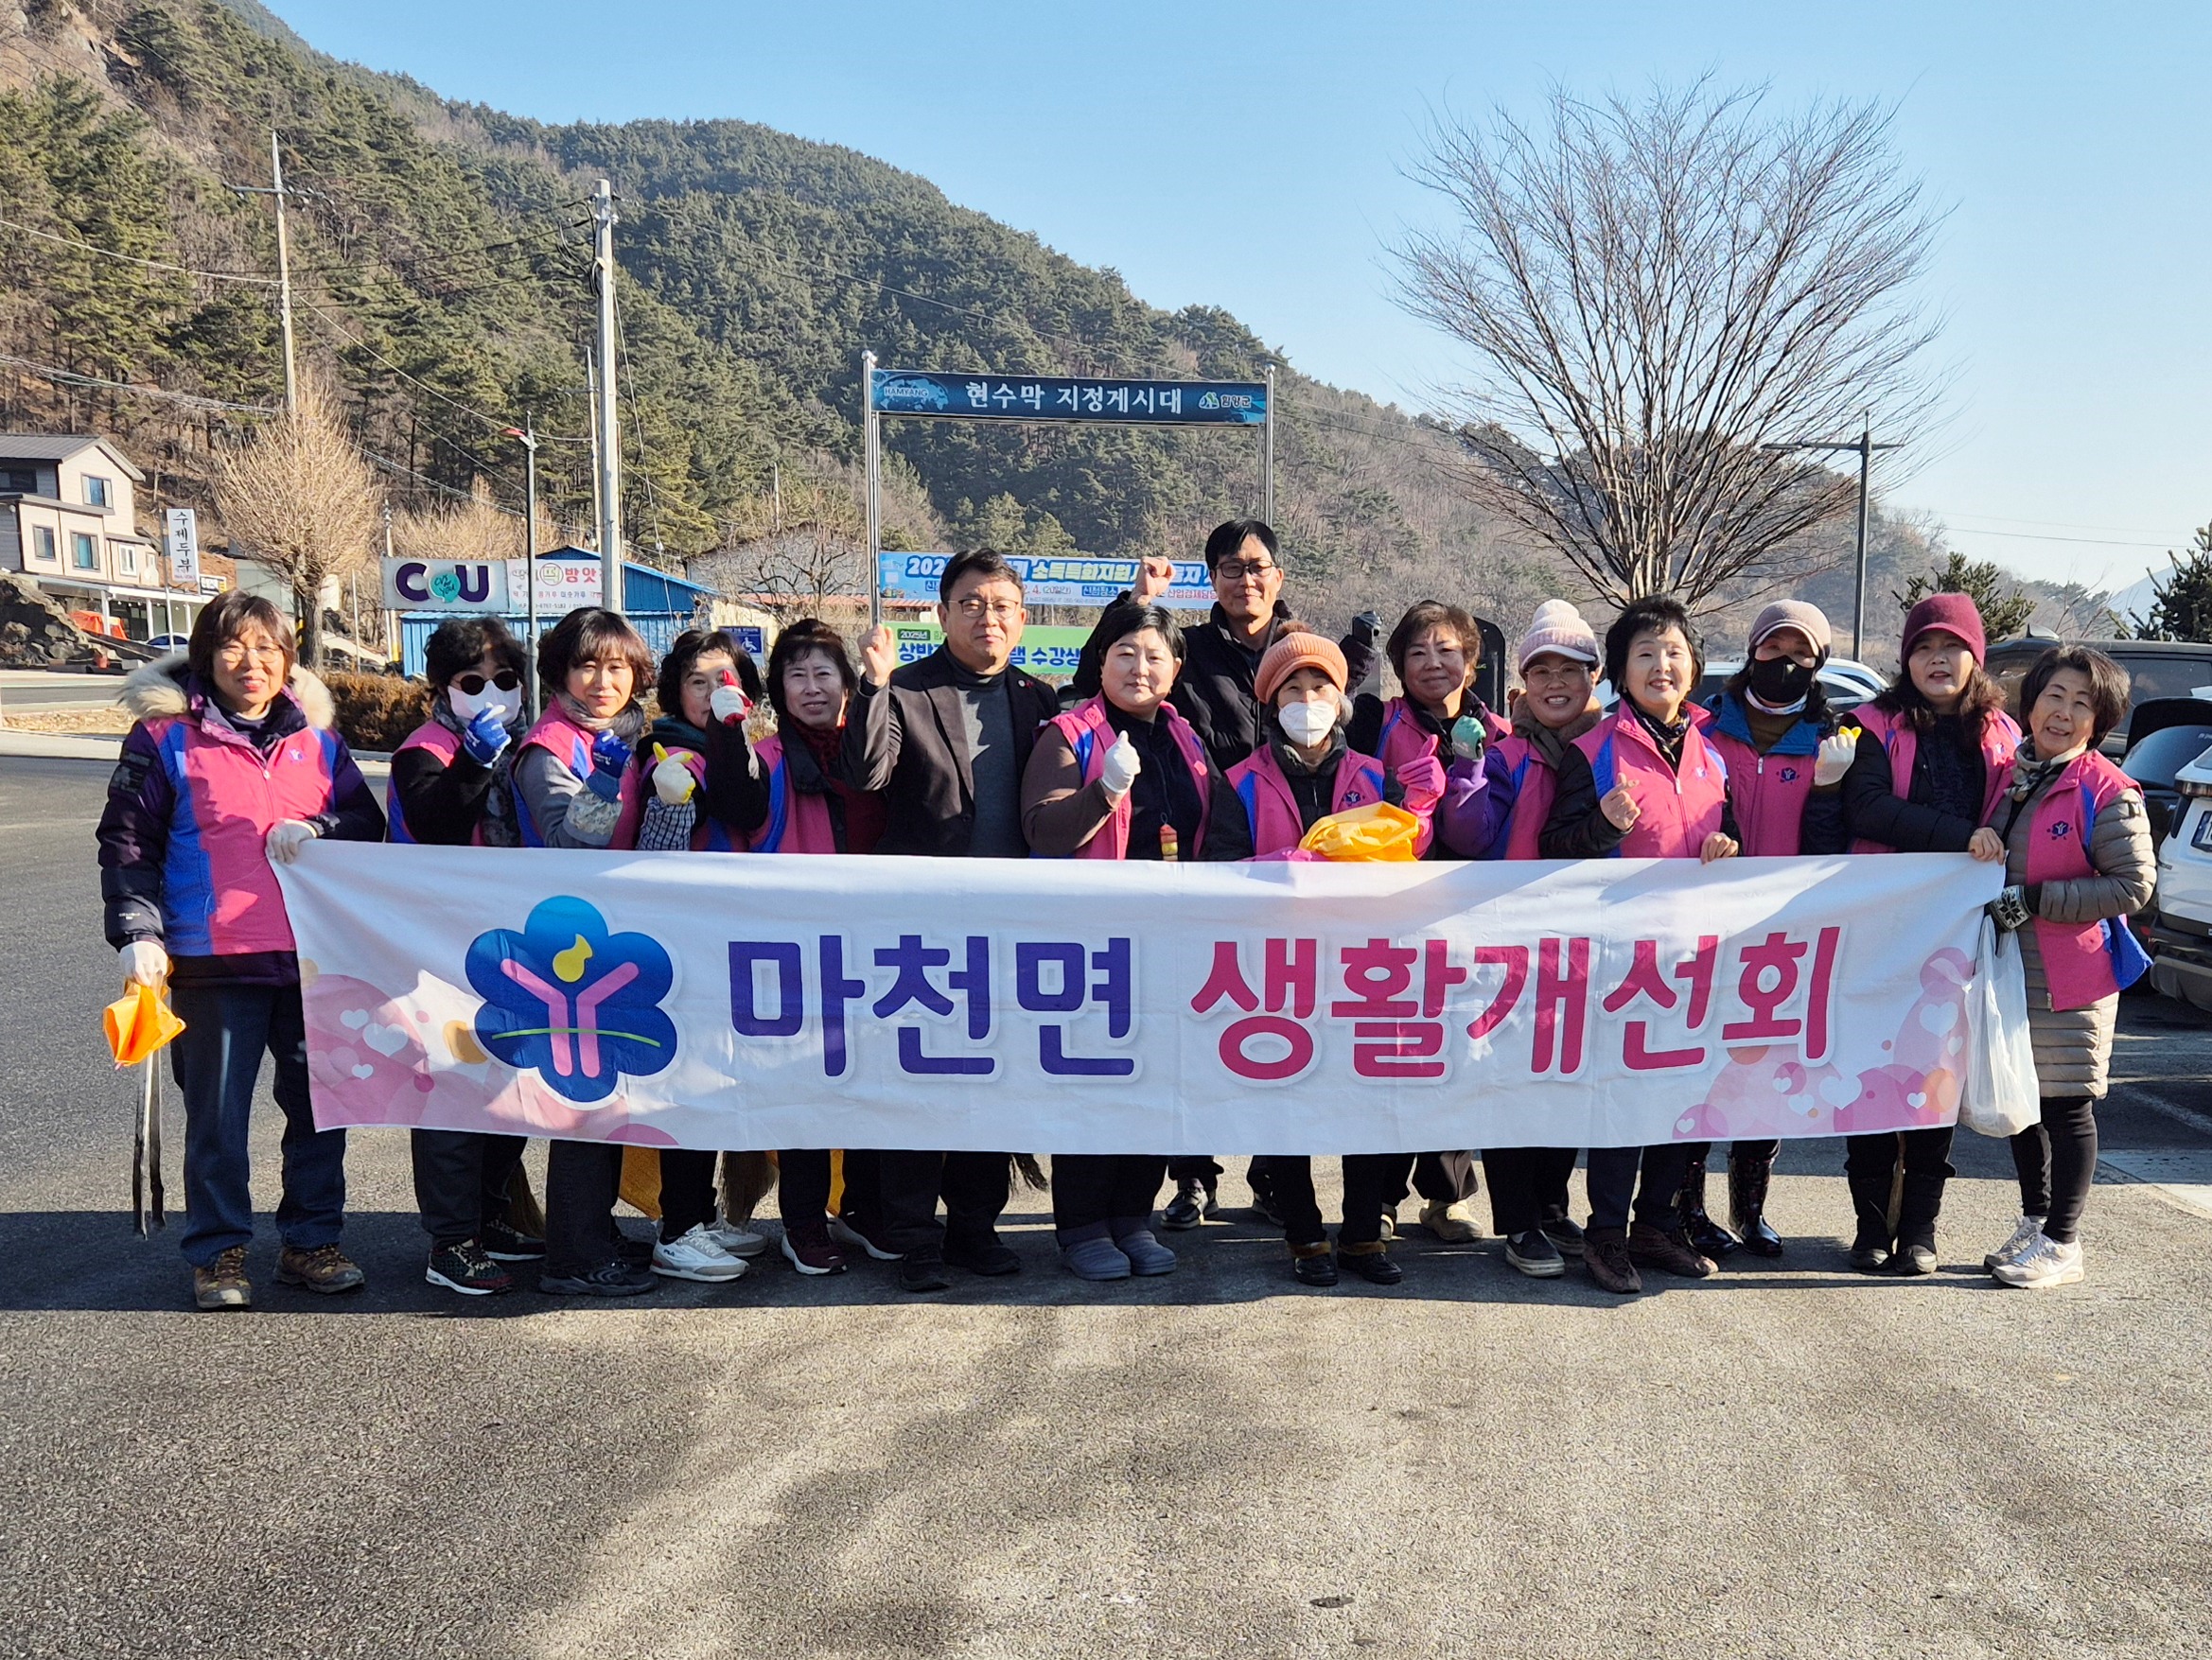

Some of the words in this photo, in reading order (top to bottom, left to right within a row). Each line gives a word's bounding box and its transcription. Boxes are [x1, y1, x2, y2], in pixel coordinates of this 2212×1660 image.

[885, 387, 928, 397] HAMYANG
[965, 381, 1045, 411] 현수막
[1056, 384, 1183, 414] 지정게시대
[173, 512, 192, 573] 수제두부
[907, 556, 949, 575] 202
[900, 630, 927, 639] 2025년
[728, 934, 1135, 1077] 마천면
[1189, 925, 1842, 1081] 생활개선회
